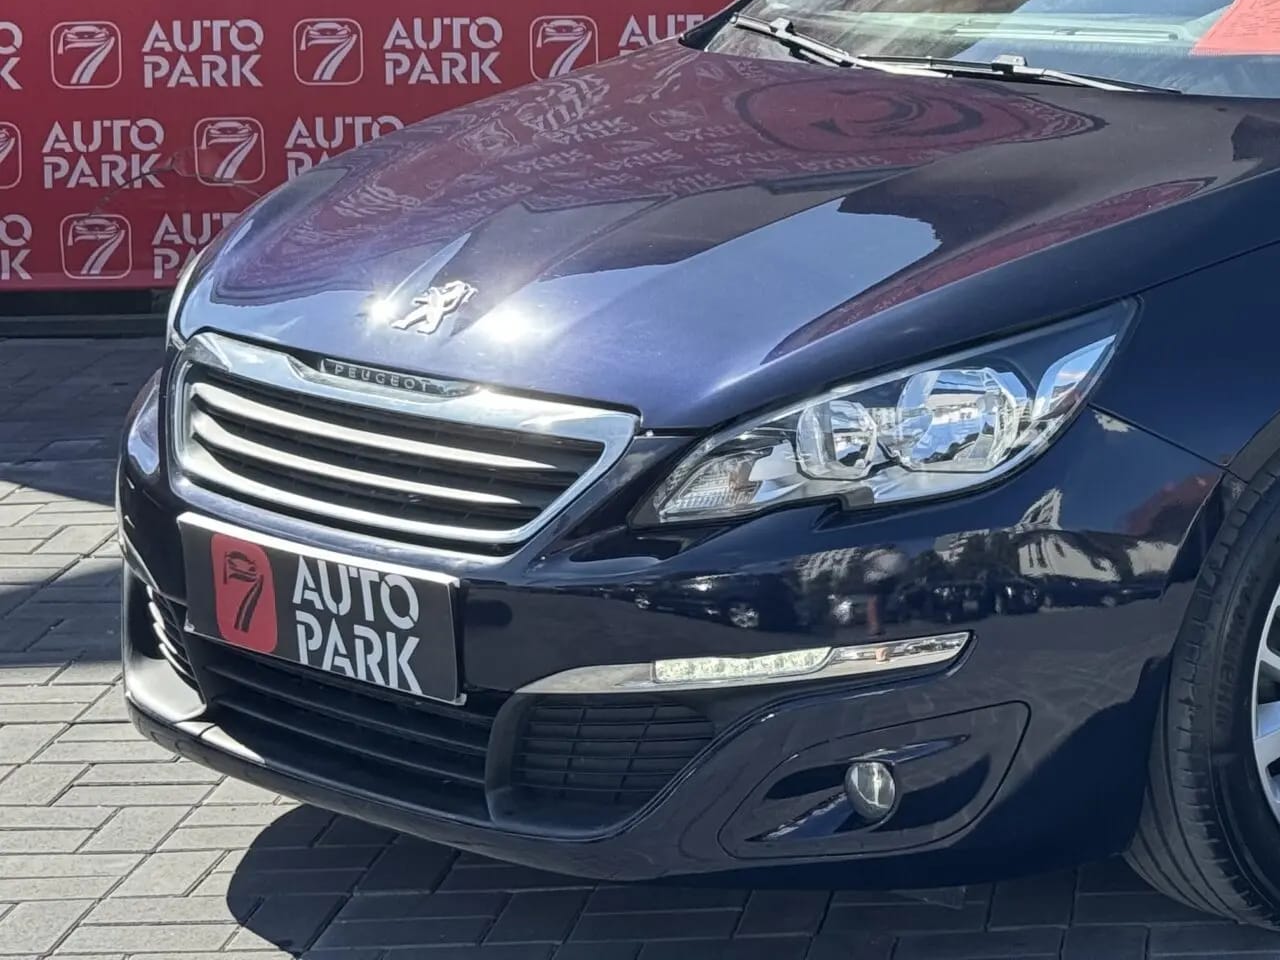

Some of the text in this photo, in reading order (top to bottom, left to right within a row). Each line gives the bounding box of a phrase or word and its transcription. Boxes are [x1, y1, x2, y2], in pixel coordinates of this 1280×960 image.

[141, 19, 264, 52] AUTO
[383, 16, 503, 50] AUTO
[144, 54, 263, 88] PARK
[385, 51, 502, 85] PARK
[42, 118, 164, 153] AUTO
[43, 154, 164, 189] PARK
[334, 363, 431, 392] PEUGEOT
[292, 555, 419, 630] AUTO
[295, 609, 423, 695] PARK
